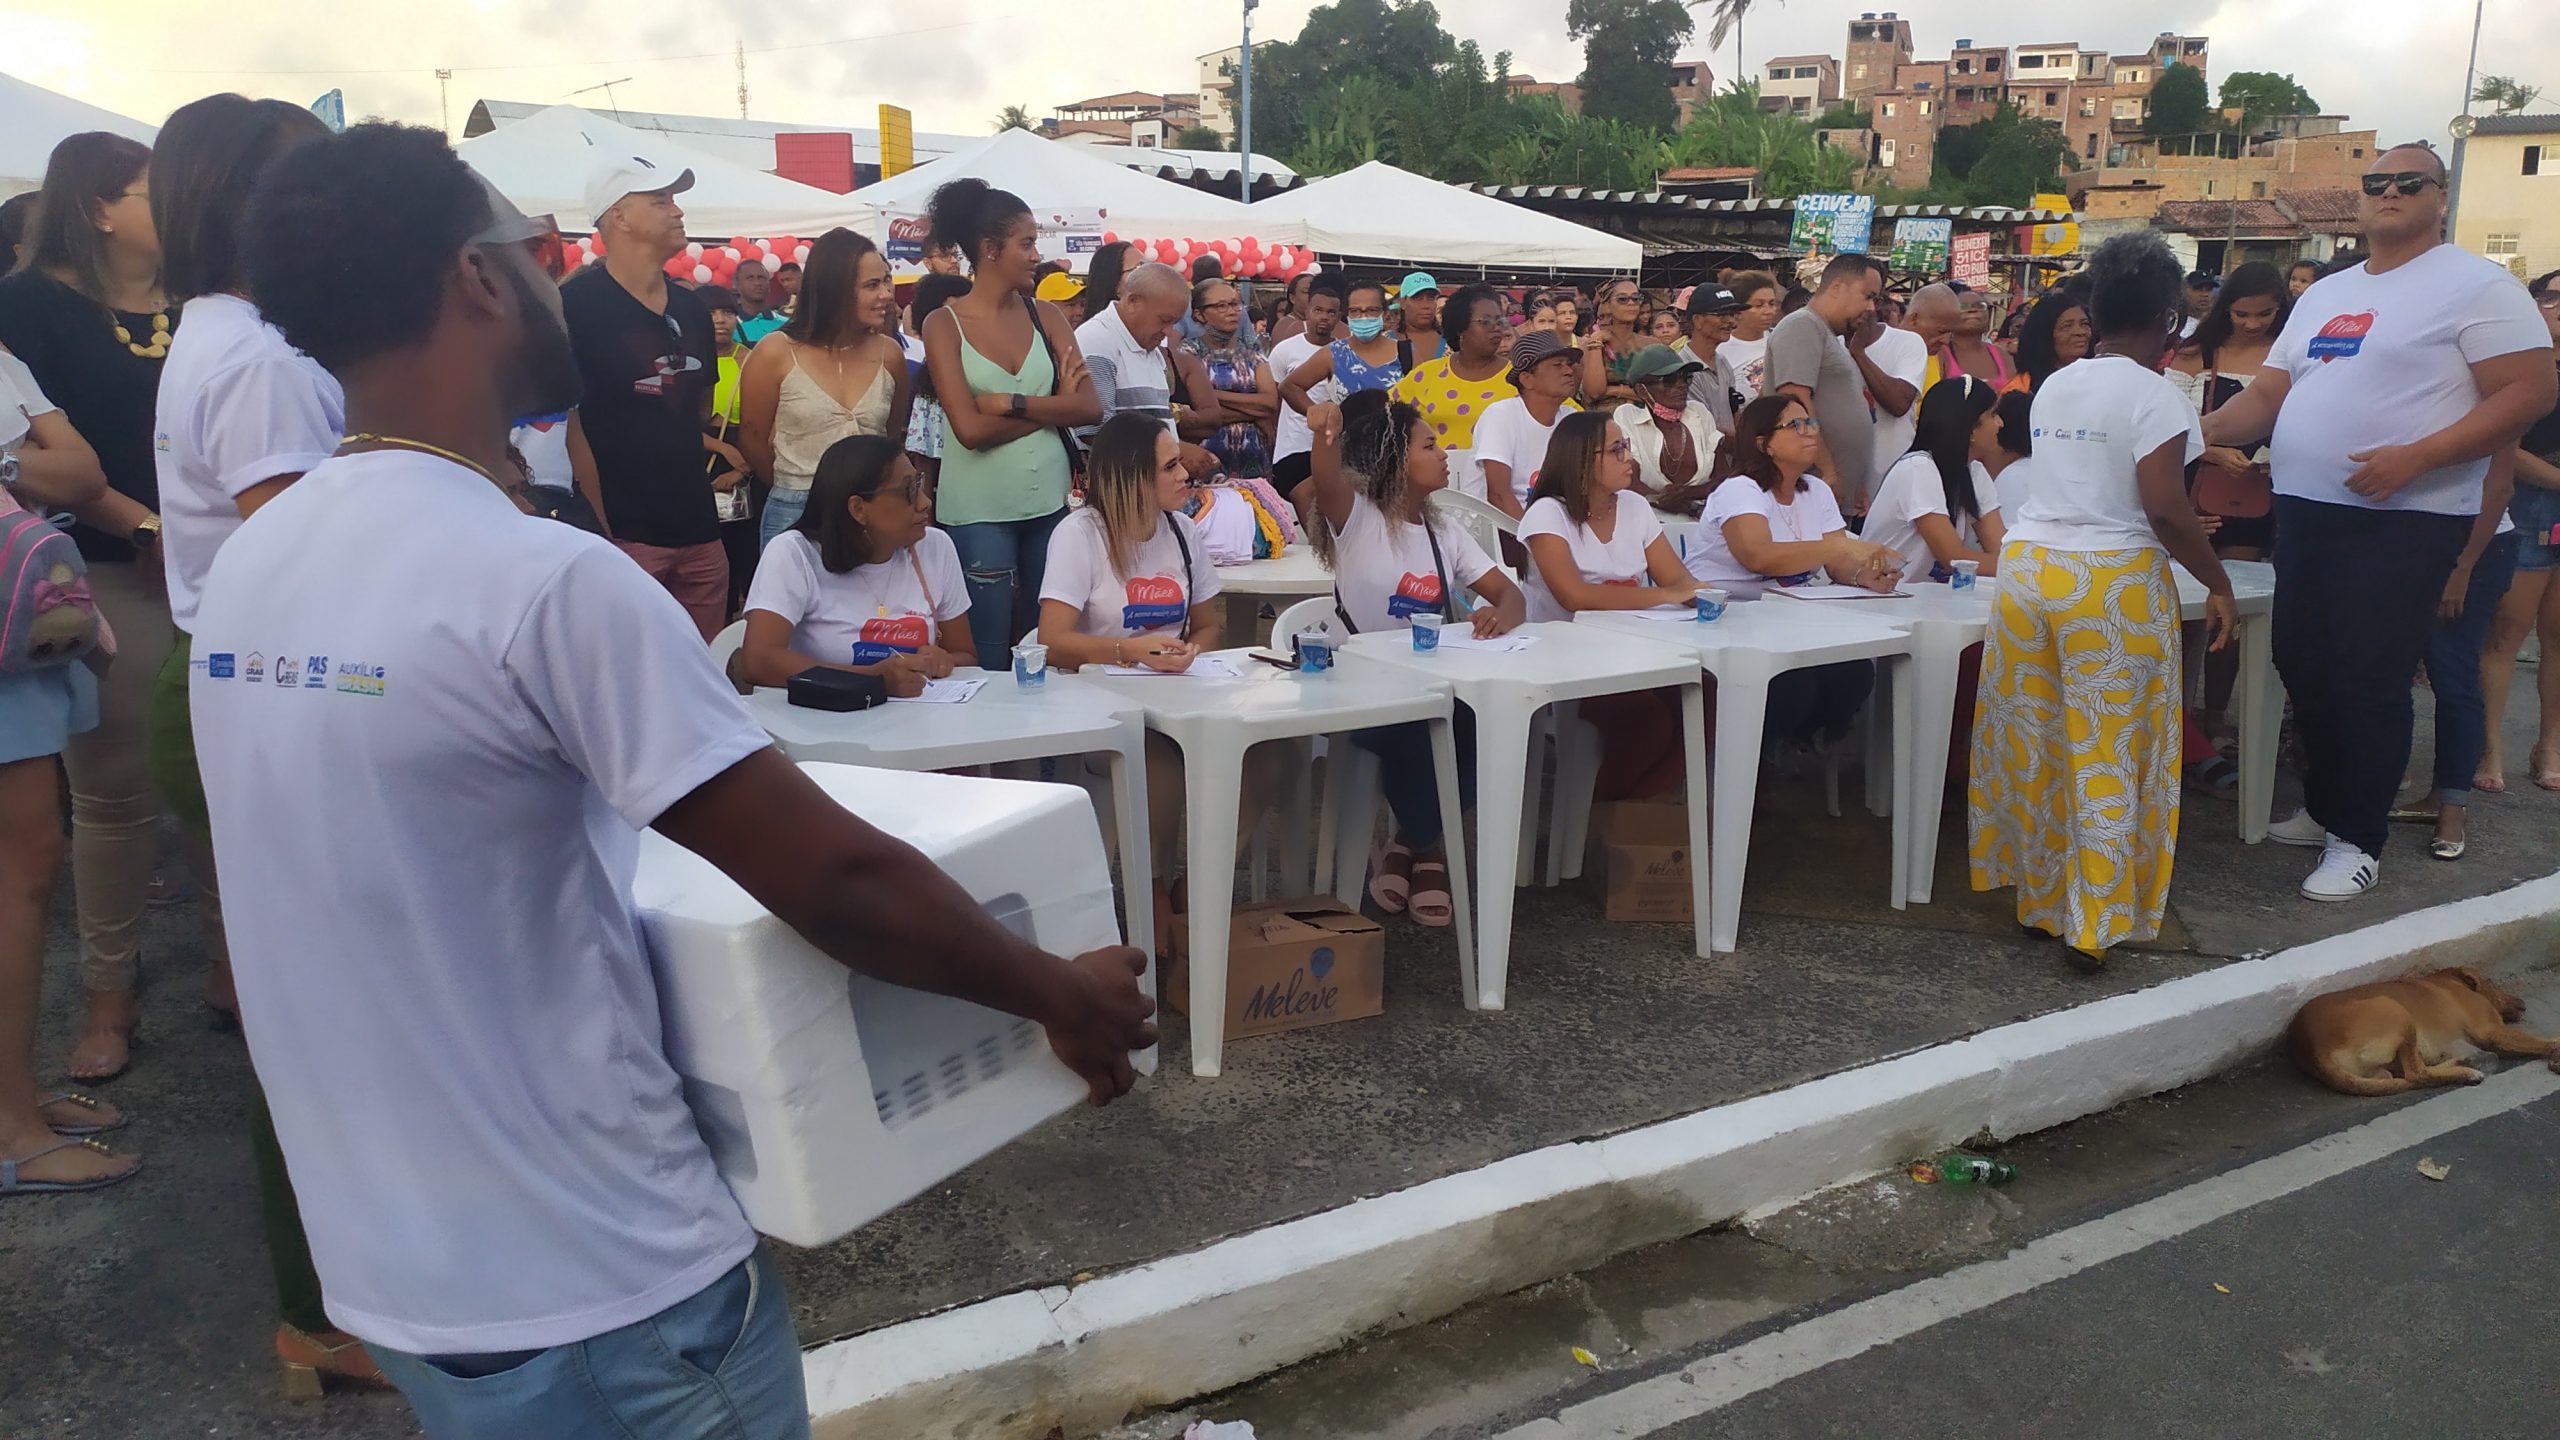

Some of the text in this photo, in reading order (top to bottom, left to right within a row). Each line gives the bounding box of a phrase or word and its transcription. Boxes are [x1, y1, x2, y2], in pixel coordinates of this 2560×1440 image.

[1797, 194, 1871, 212] CERVEJA
[1954, 235, 1990, 252] HEINEKEN
[1955, 249, 1986, 264] 51 ICE
[1954, 262, 1989, 278] RED BULL
[871, 620, 920, 640] Mães
[1242, 967, 1339, 1022] Meleve
